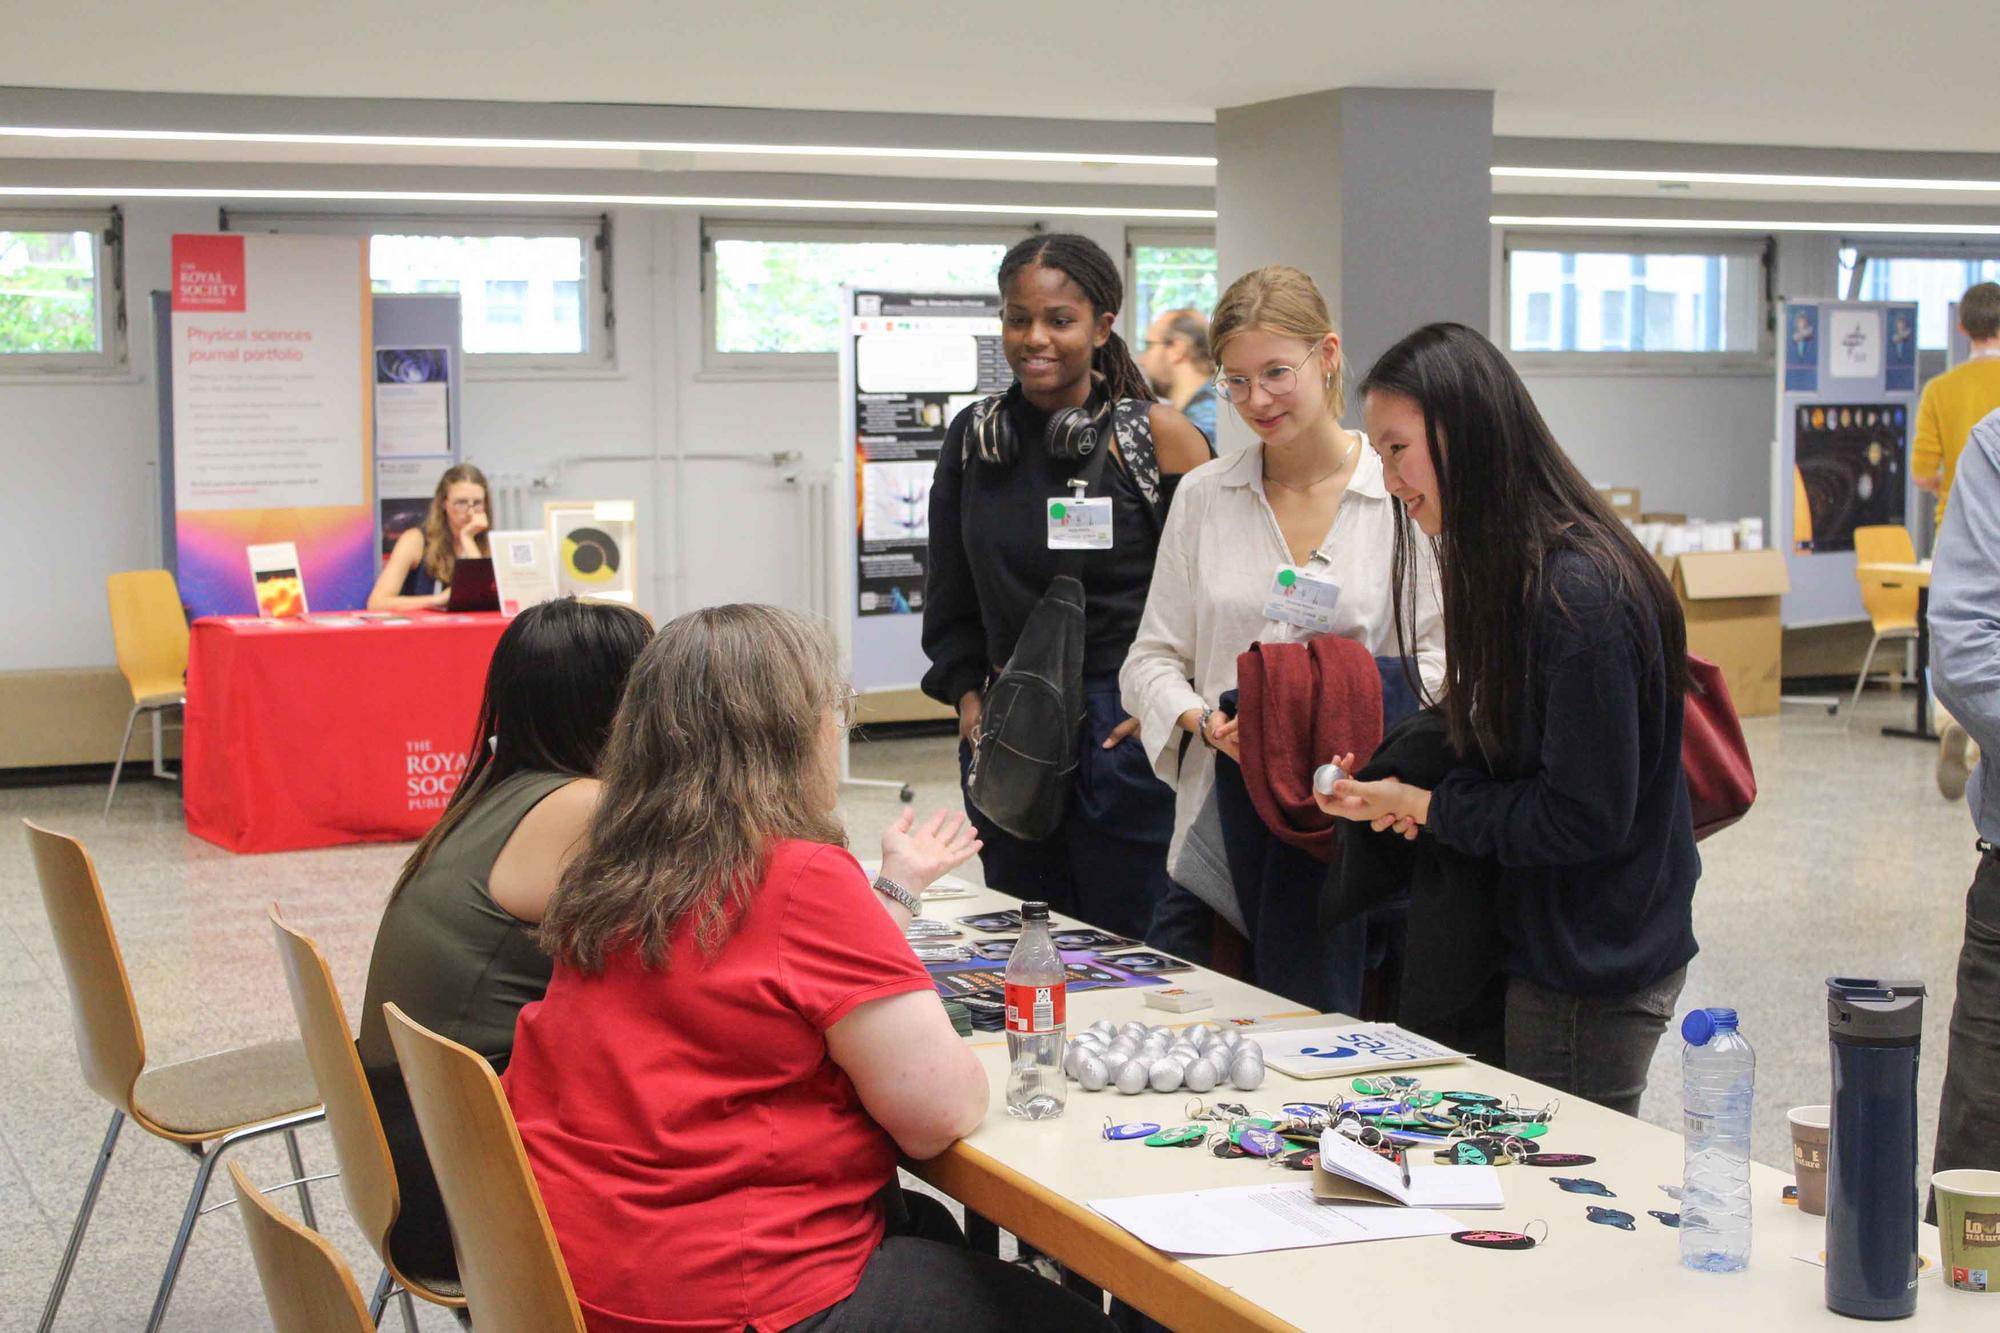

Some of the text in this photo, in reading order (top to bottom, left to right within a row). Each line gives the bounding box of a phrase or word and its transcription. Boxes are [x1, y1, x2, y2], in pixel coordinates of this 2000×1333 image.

[180, 271, 223, 283] ROYAL
[180, 284, 237, 297] SOCIETY
[187, 326, 312, 345] Physical sciences
[188, 347, 304, 365] journal portfolio
[406, 740, 432, 752] THE
[407, 774, 463, 797] SOC
[408, 797, 450, 811] PUBLI
[1337, 1033, 1417, 1061] cnes
[1794, 1143, 1820, 1162] LOE
[1795, 1156, 1821, 1169] nature
